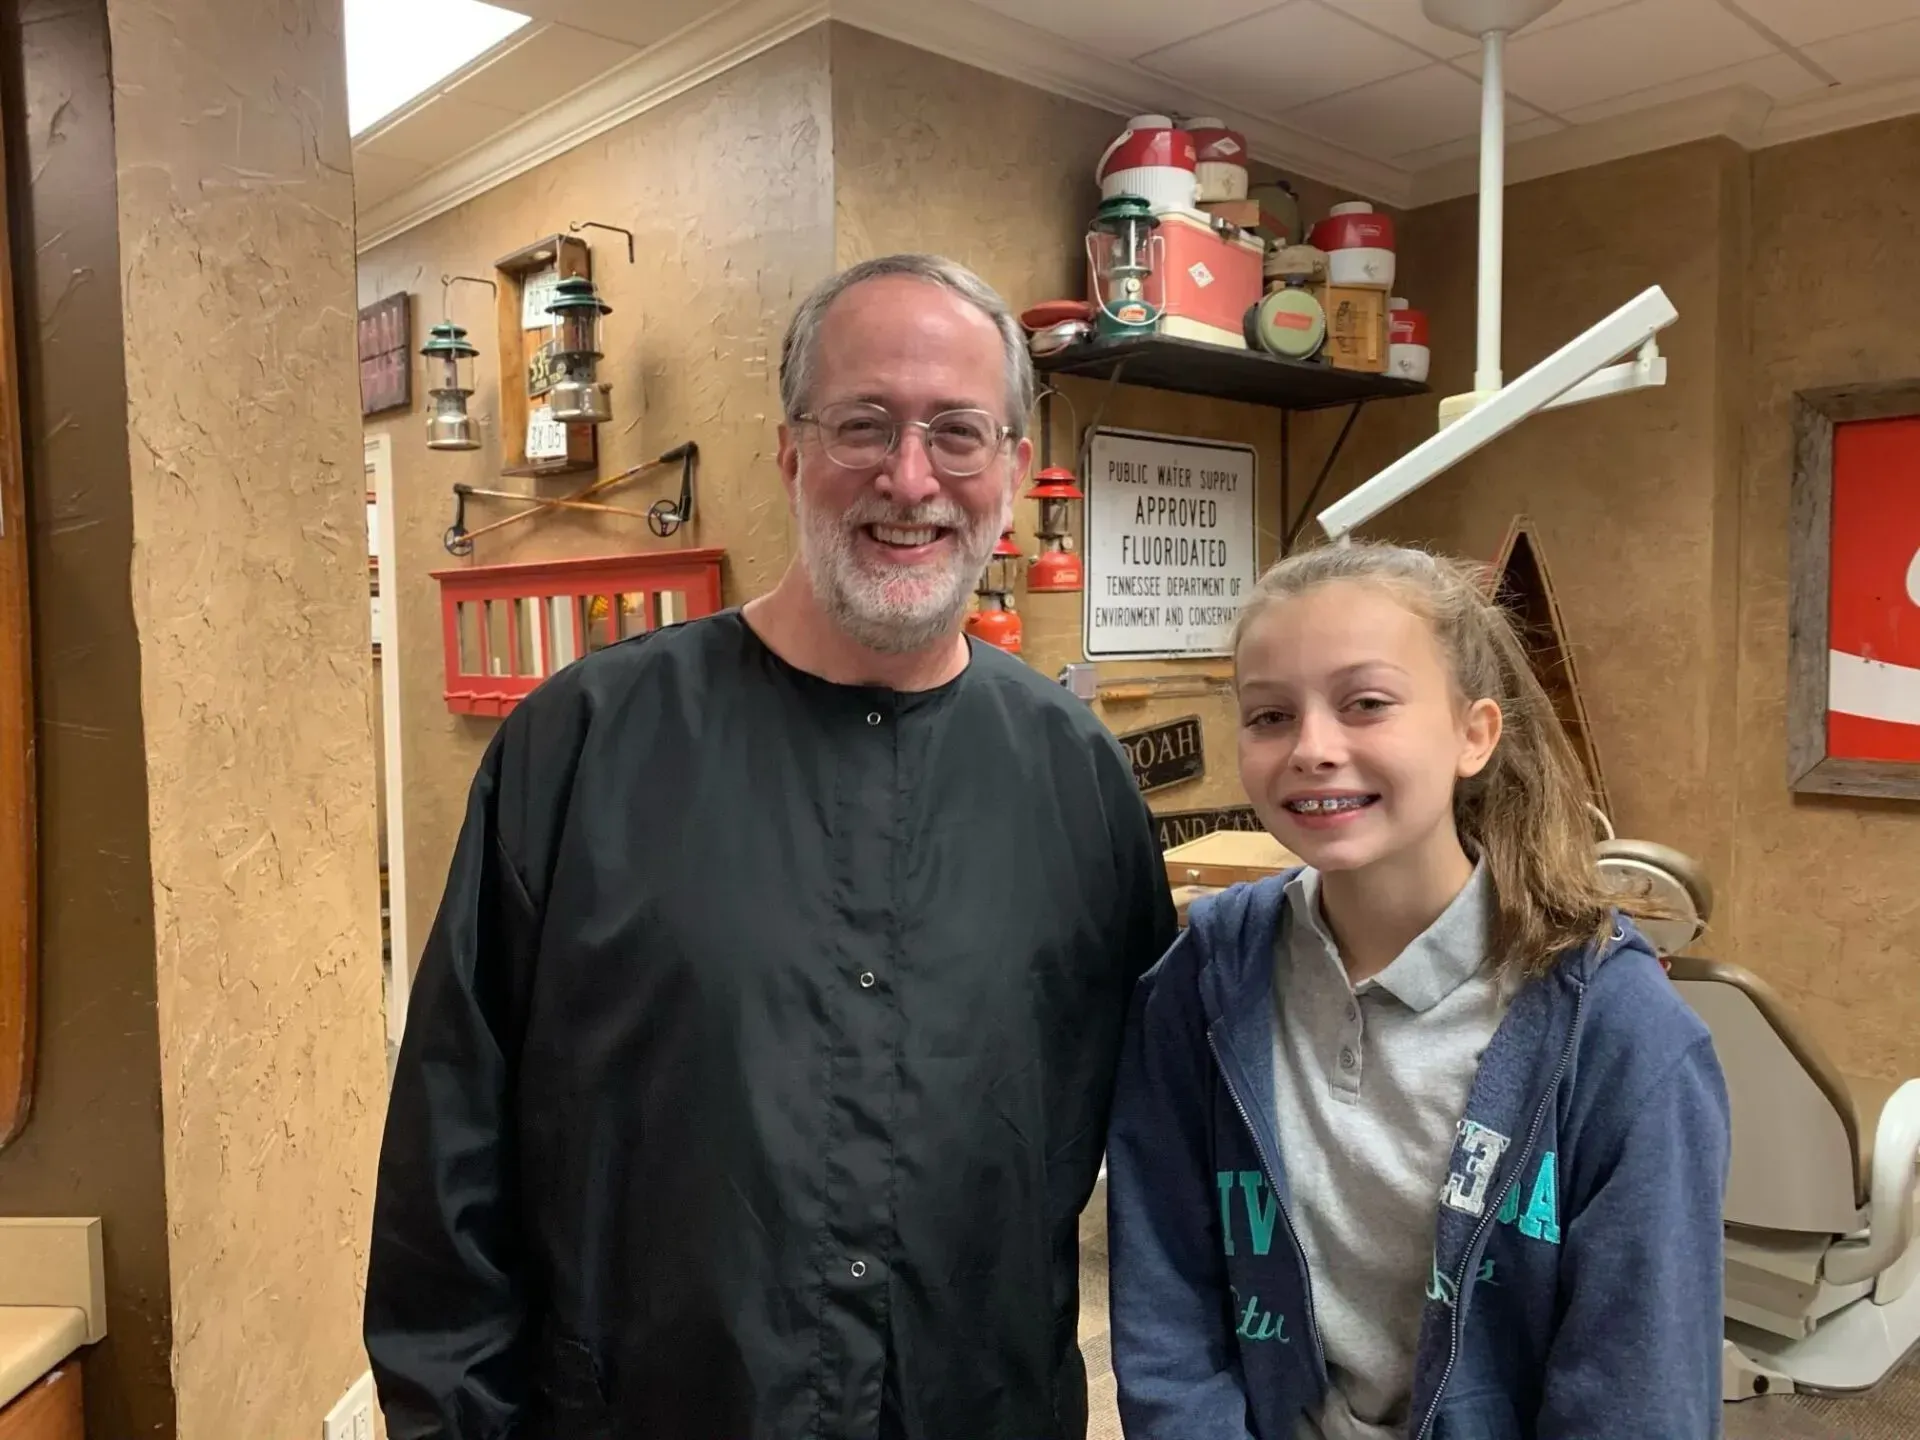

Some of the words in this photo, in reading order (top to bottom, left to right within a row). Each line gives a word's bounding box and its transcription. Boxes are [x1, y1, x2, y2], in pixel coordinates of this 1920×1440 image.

[1108, 460, 1149, 485] PUBLIC
[1157, 464, 1192, 489] WATER
[1200, 470, 1239, 492] SUPPLY
[1135, 495, 1218, 529] APPROVED
[1122, 535, 1228, 568] FLUORIDATED
[1106, 575, 1161, 597] TENNESSEE
[1166, 576, 1225, 597] DEPARTMENT
[1230, 577, 1242, 597] OF
[1095, 607, 1160, 628] ENVIRONMENT
[1165, 606, 1184, 627] AND
[1189, 606, 1242, 626] CONSERVAT
